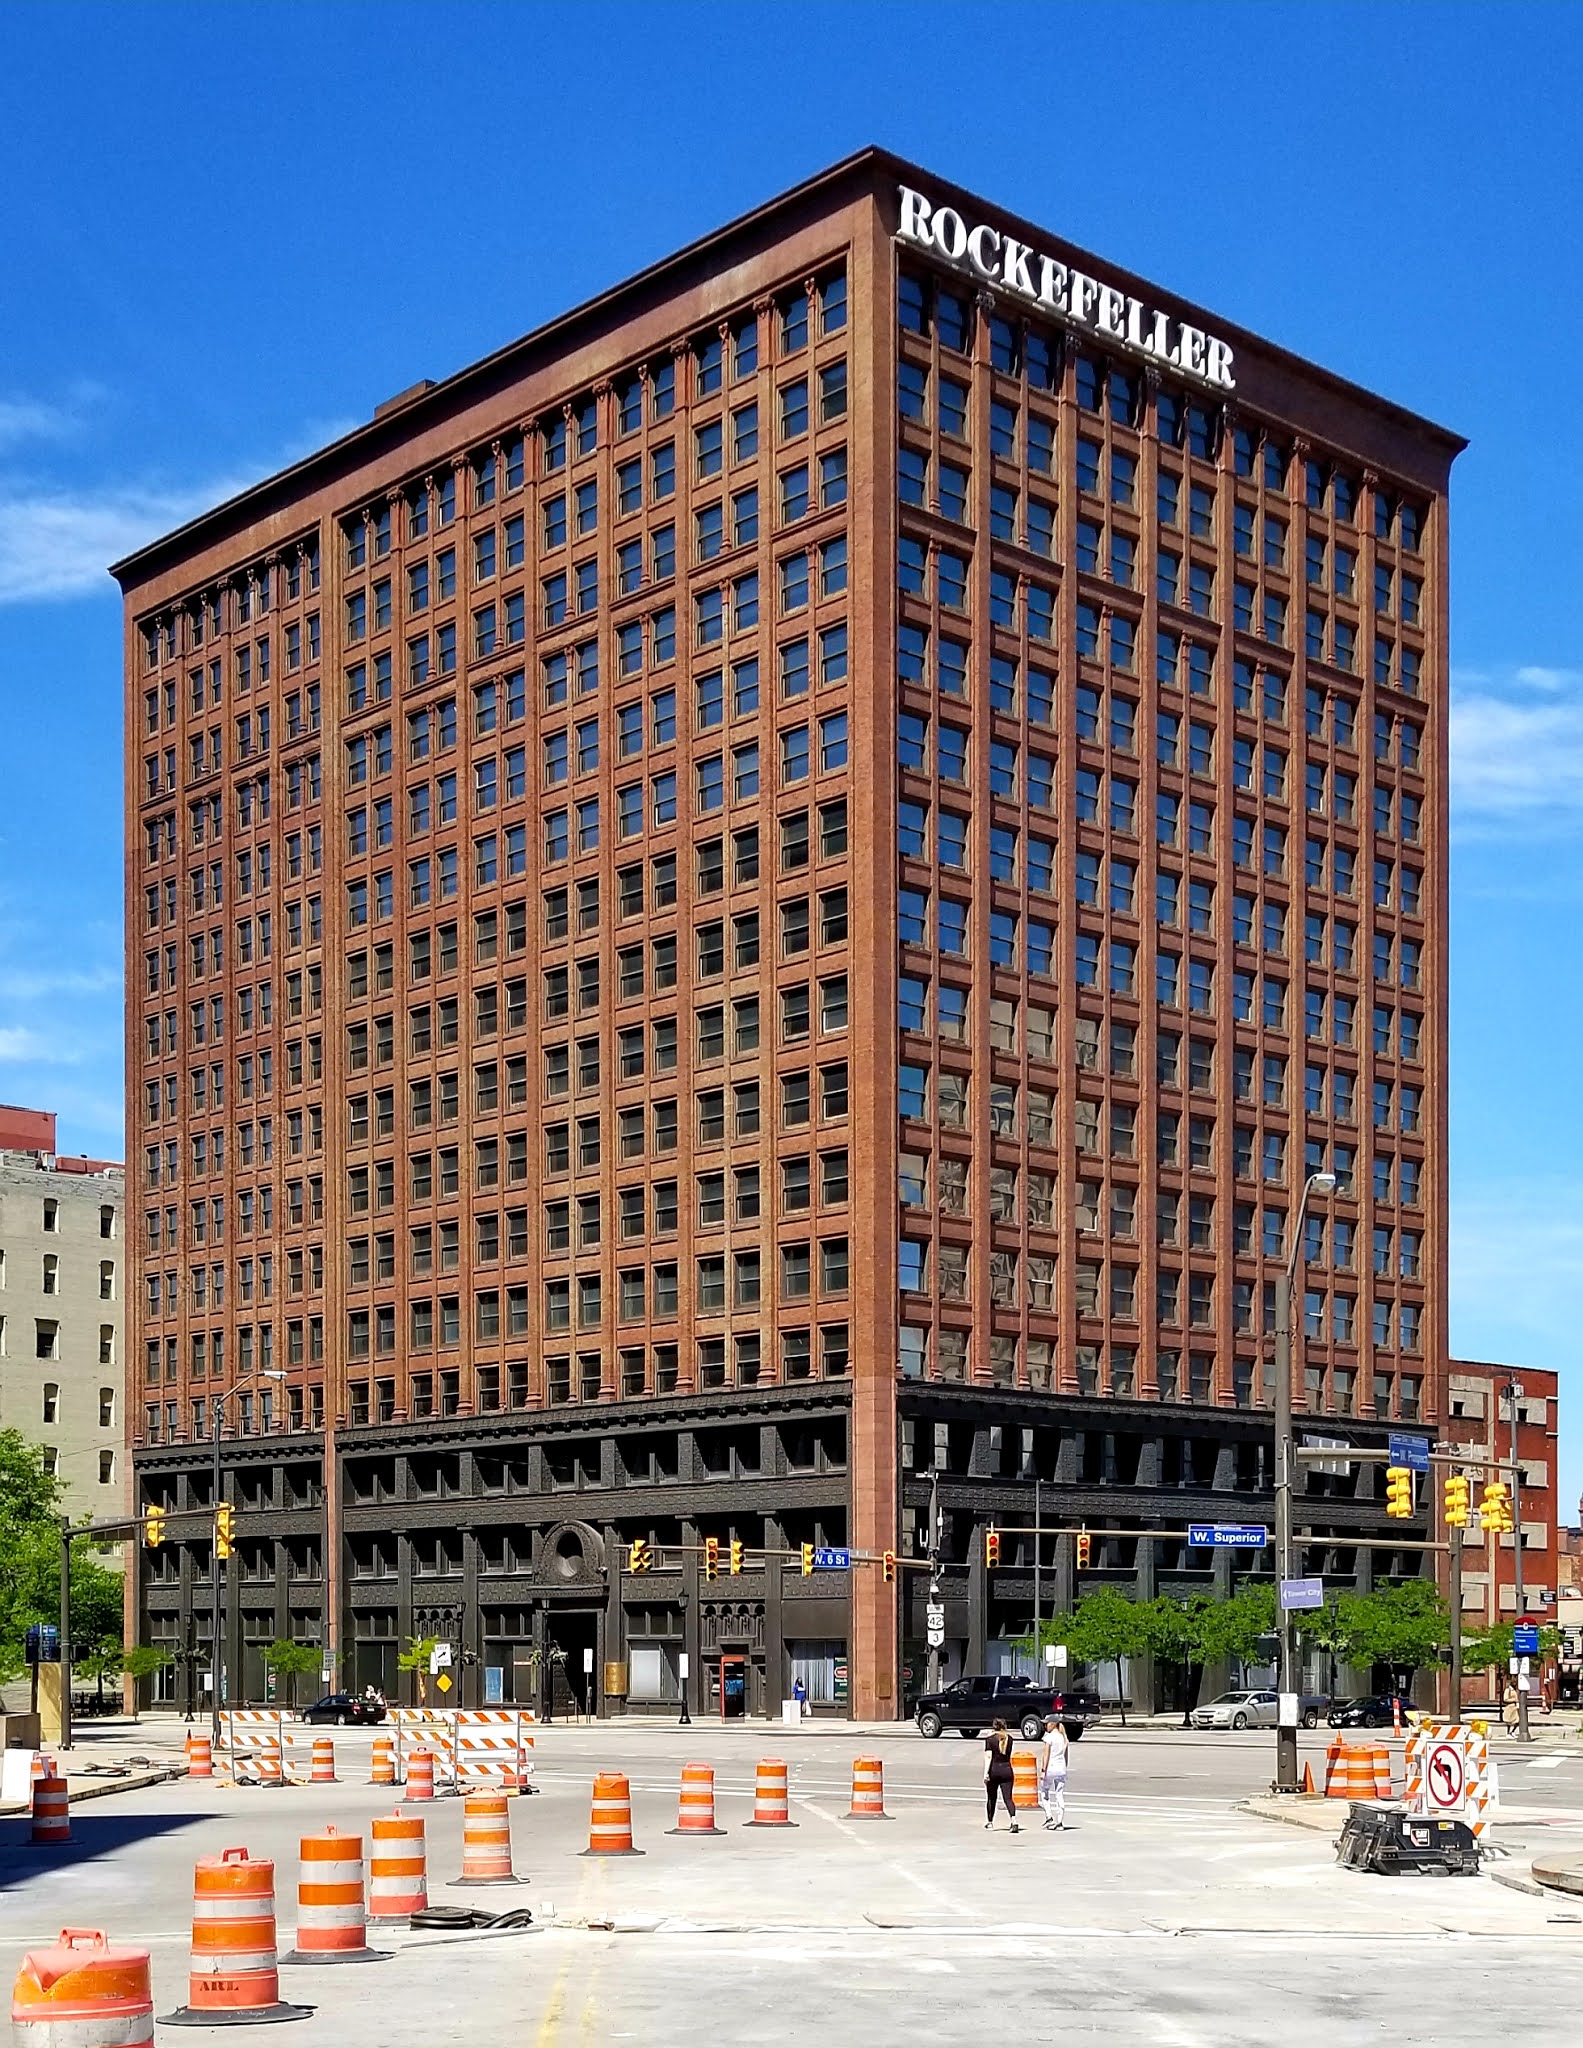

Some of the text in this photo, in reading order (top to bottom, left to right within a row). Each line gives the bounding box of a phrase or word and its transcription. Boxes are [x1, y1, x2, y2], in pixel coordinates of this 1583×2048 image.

[896, 184, 1236, 390] ROCKEFELLER
[1193, 1531, 1262, 1545] W. Superior
[827, 1554, 834, 1565] 6
[835, 1554, 846, 1565] St
[929, 1616, 942, 1626] 42
[933, 1632, 939, 1643] 3
